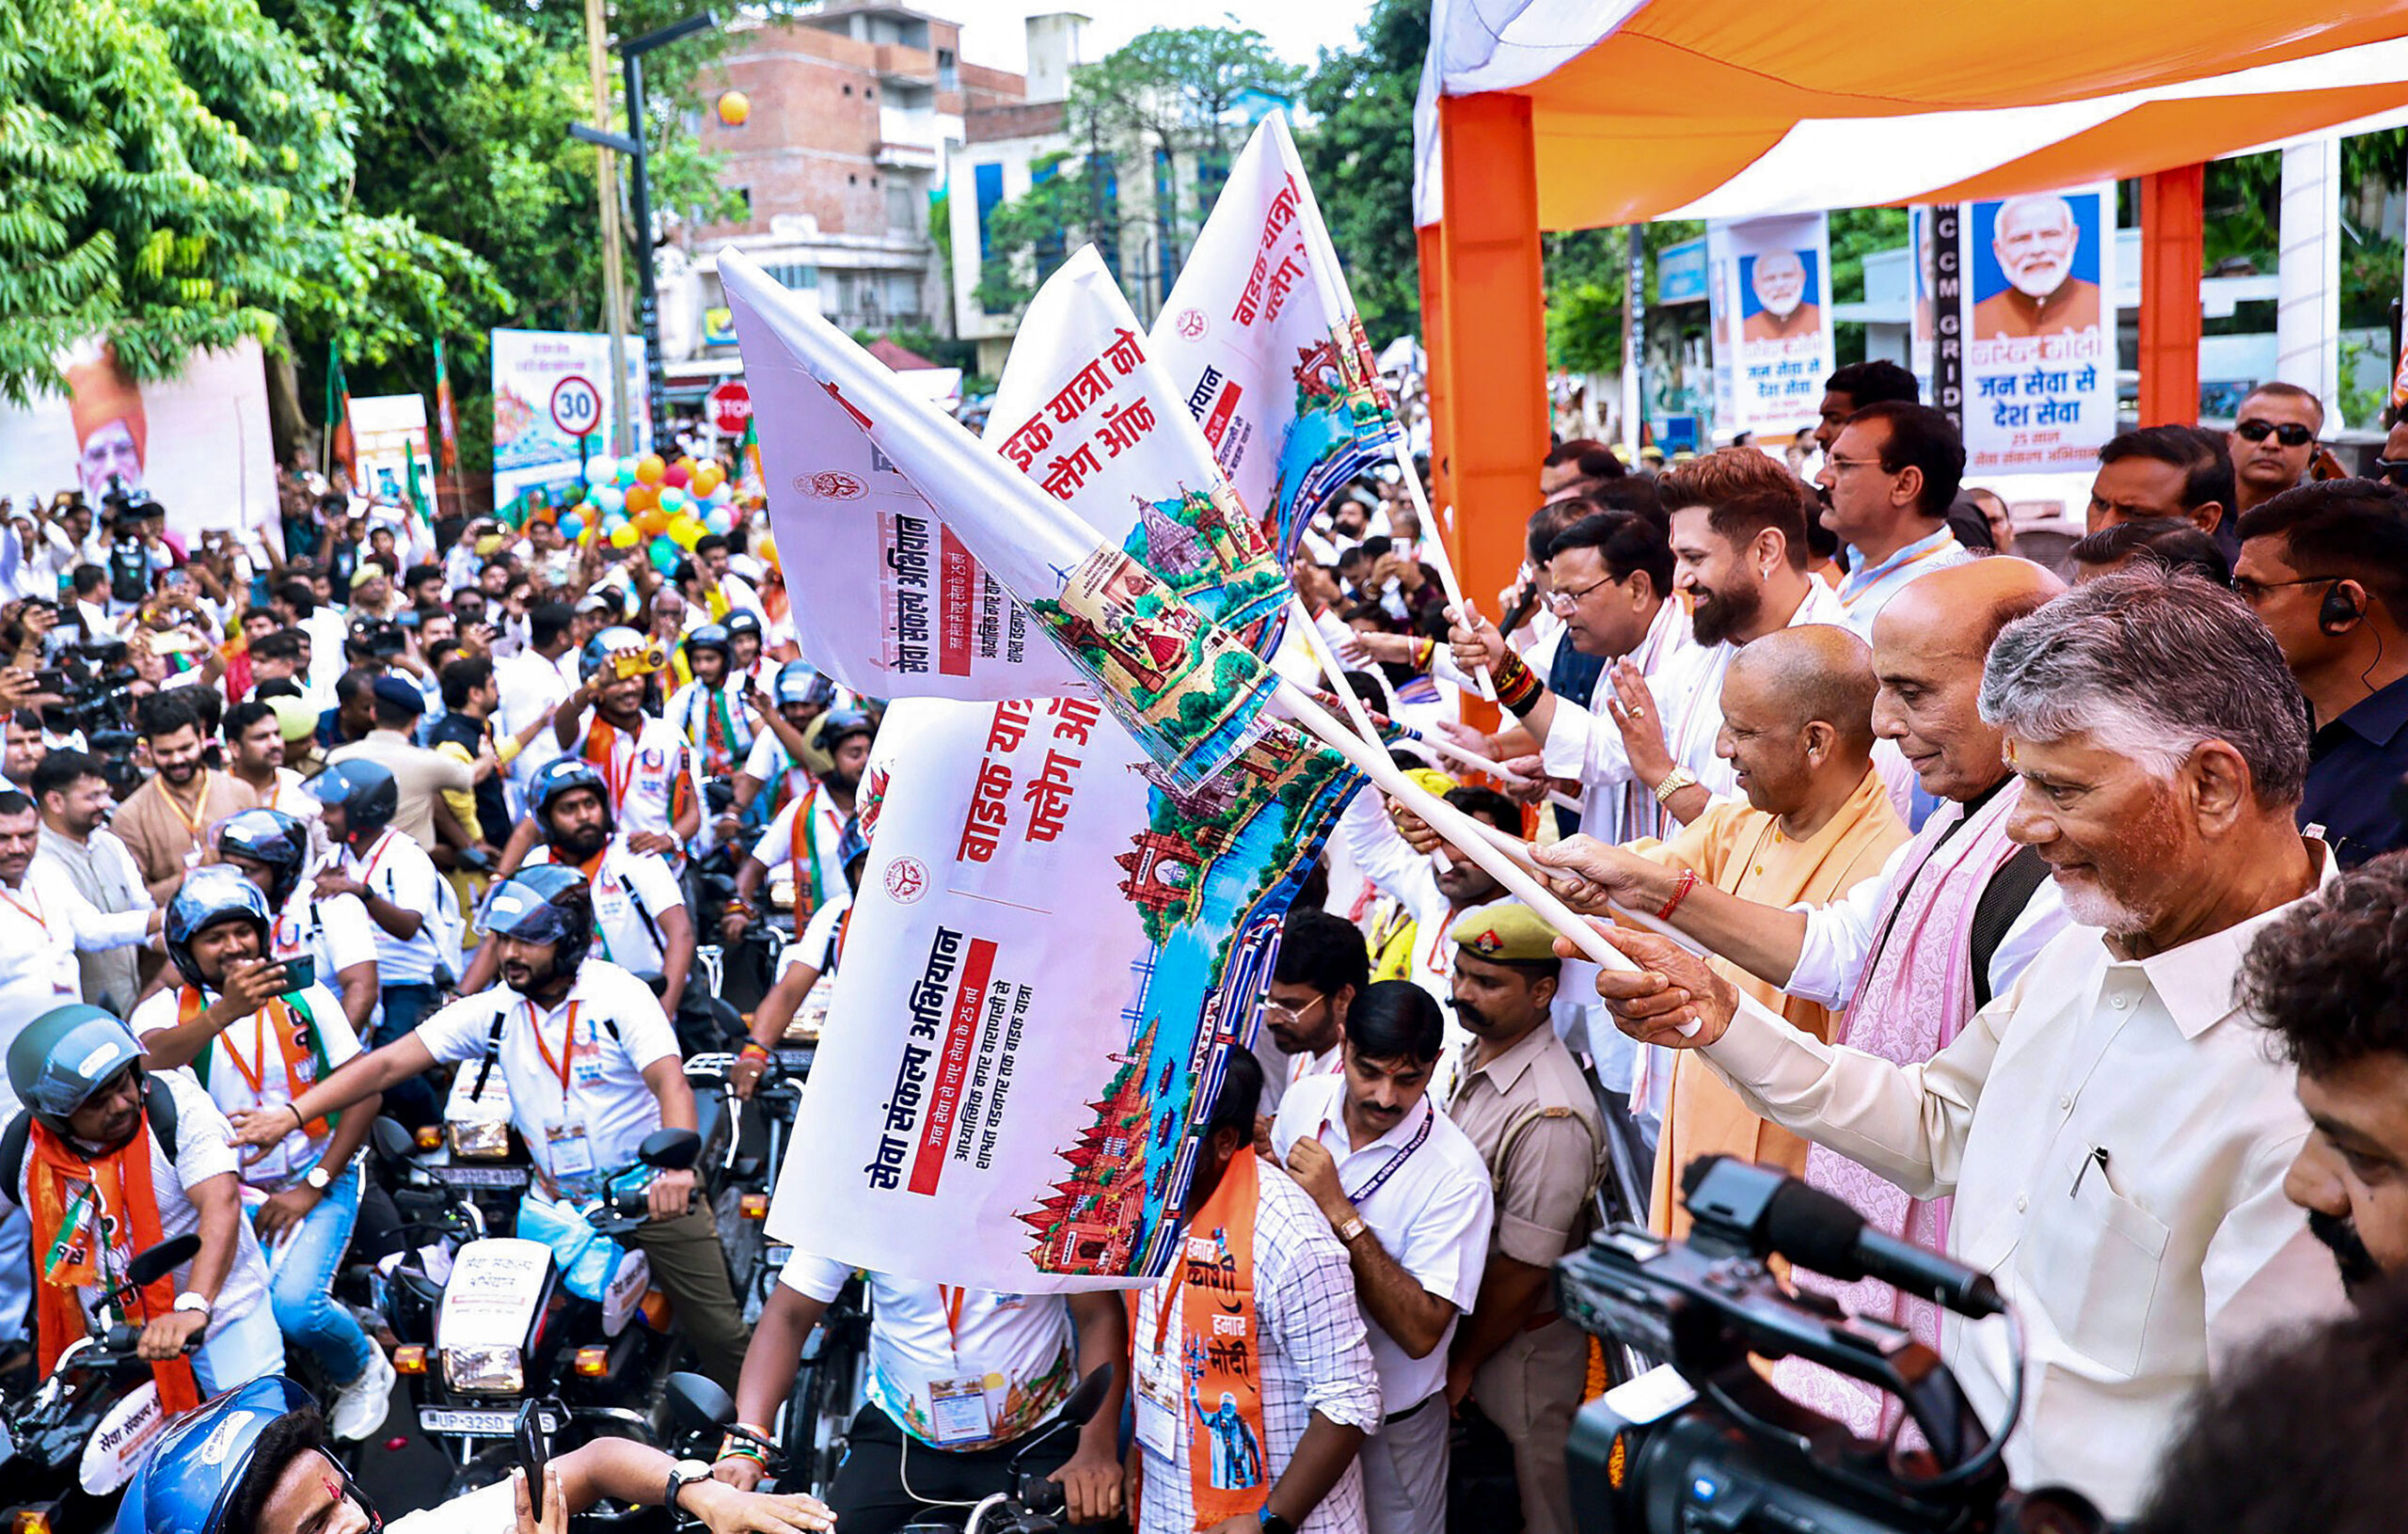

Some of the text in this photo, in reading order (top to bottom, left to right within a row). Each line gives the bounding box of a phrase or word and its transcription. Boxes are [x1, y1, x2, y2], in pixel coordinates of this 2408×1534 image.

[1231, 249, 1268, 327] बाइक
[561, 392, 592, 420] 30
[997, 327, 1147, 474] इक यात्रा को
[1975, 362, 2097, 399] जन सेवा से
[1992, 394, 2080, 428] देश सेवा
[1094, 395, 1156, 459] ऑफ
[887, 513, 929, 674] सेवा संकल्प अभियान
[950, 565, 966, 576] 25
[977, 616, 1001, 658] आध्यात्मिक
[984, 595, 1001, 616] नगर
[1023, 697, 1102, 843] फ्लैग ऑ
[956, 757, 1013, 863] बाइक
[863, 925, 963, 1191] सेवा संकल्प अभियान
[928, 987, 980, 1147] जन सेवा से राष्ट्र सेवा के 25 वर्ष
[954, 980, 1012, 1162] आध्यात्मिक नगर वाराणसी से
[975, 984, 1034, 1171] शाश्वत वडनगर तक बाइक यात्रा
[1212, 1314, 1246, 1336] हमार
[1208, 1339, 1256, 1392] मोदी
[98, 1429, 122, 1453] सेवा
